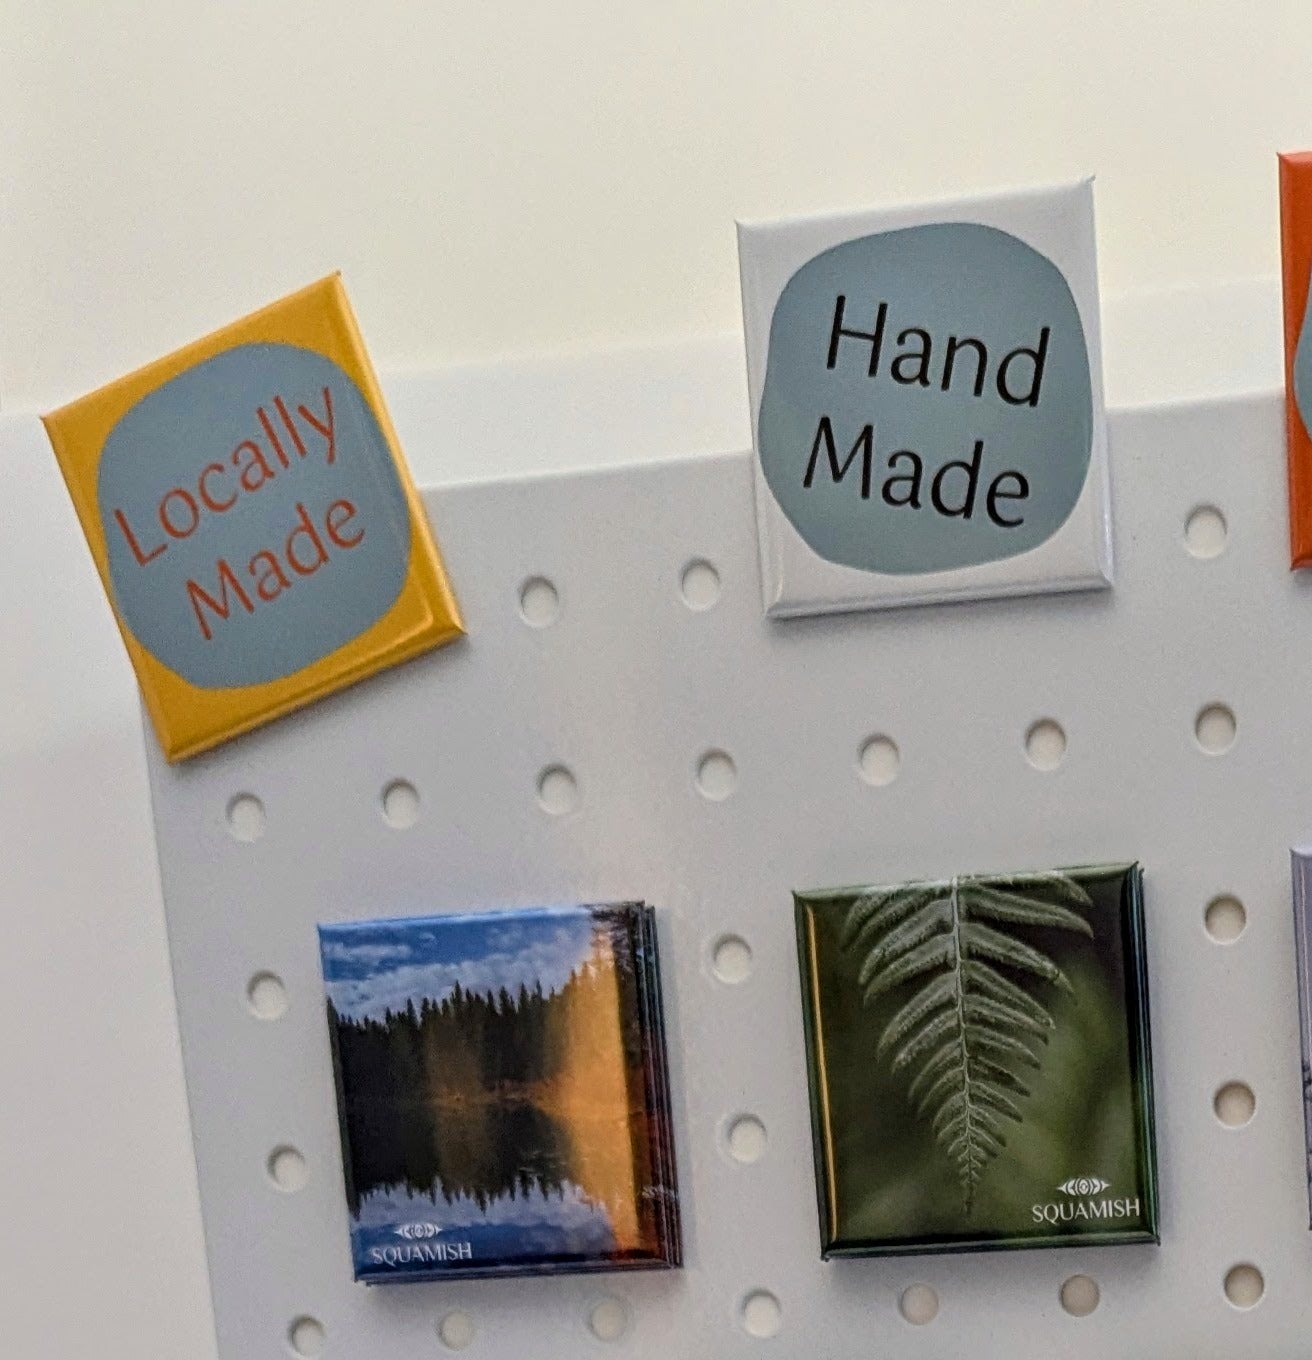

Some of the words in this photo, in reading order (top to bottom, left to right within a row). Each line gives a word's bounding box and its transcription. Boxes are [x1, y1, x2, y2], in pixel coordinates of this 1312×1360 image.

[824, 293, 1052, 409] Hand
[112, 385, 338, 567] Locally
[801, 415, 1032, 529] Made
[185, 490, 367, 643] Made
[371, 1242, 472, 1266] SQUAMISH
[1032, 1198, 1140, 1224] SQUAMISH
